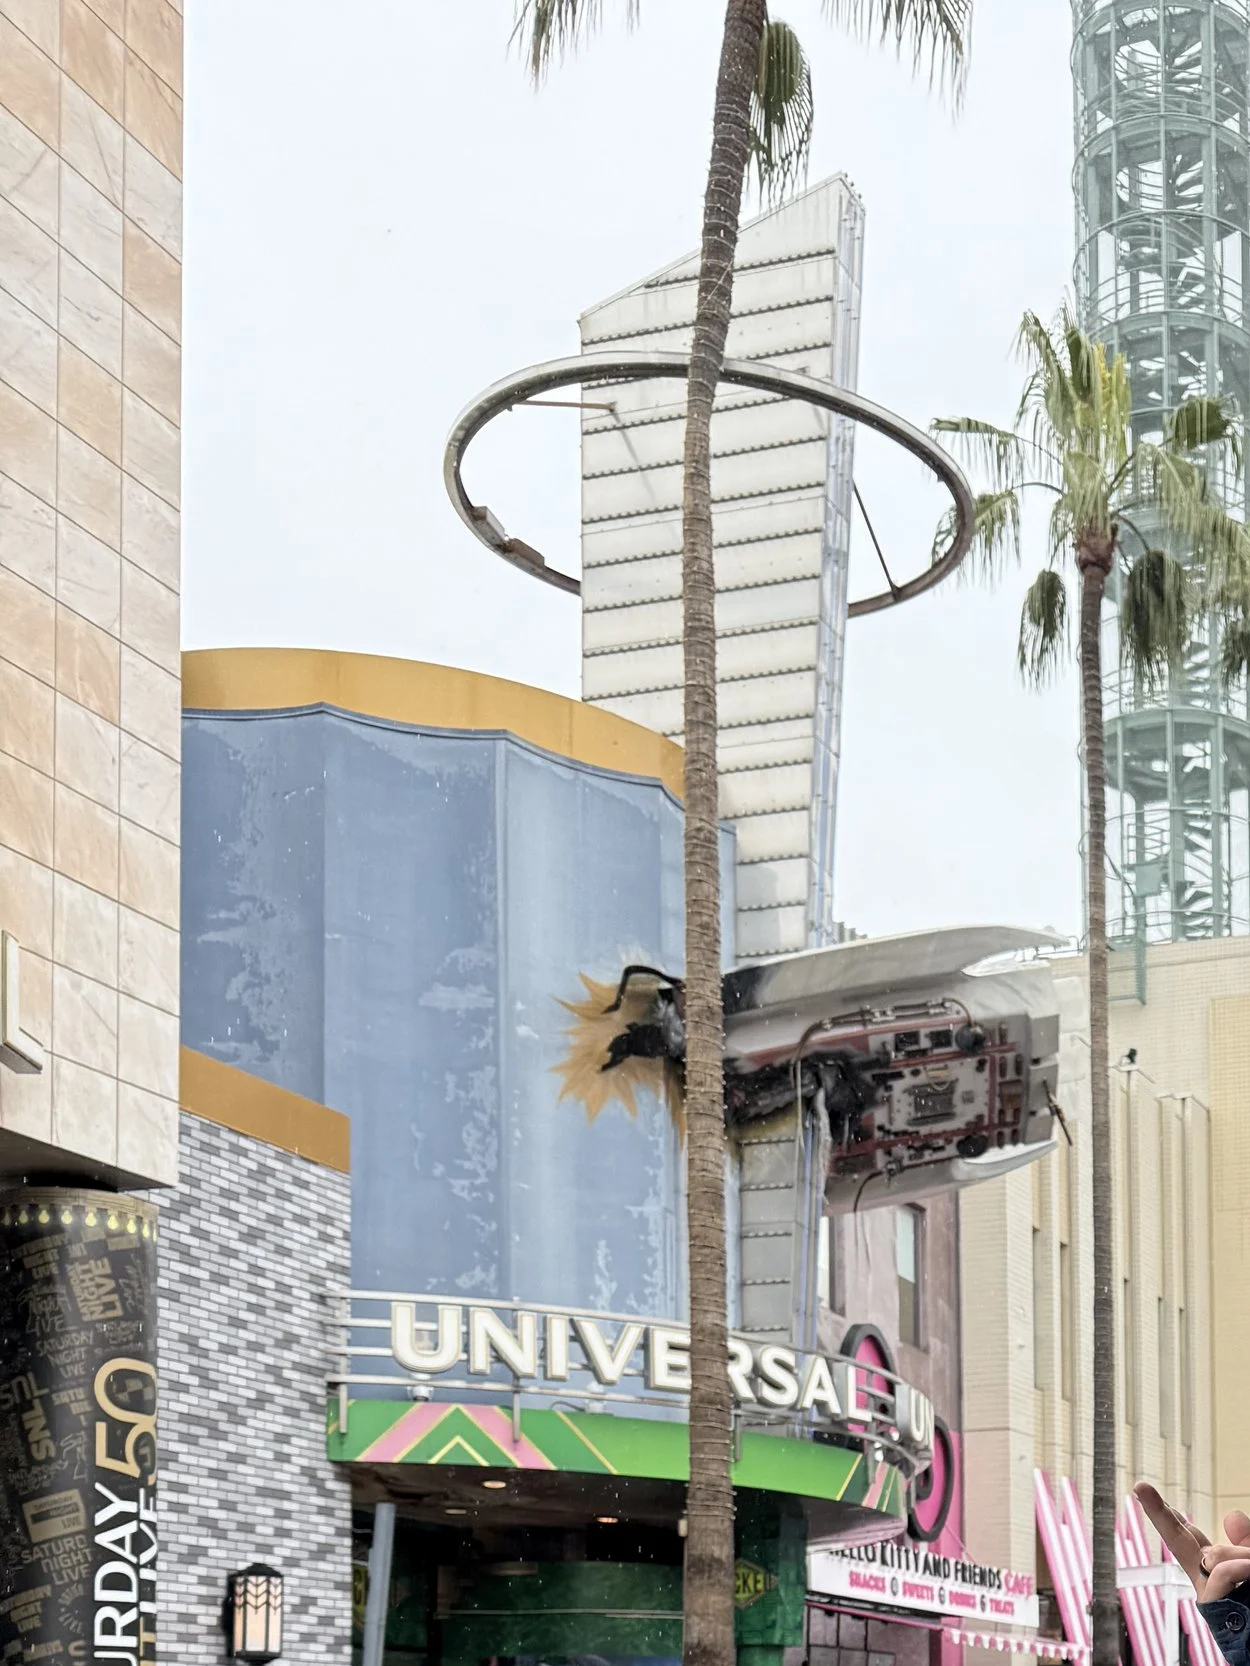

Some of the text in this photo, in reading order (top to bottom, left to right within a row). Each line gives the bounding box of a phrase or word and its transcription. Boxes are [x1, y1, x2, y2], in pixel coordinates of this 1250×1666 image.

[879, 1542, 920, 1572] KITTY
[922, 1551, 951, 1579] AND
[954, 1560, 1003, 1589] FRIENDS
